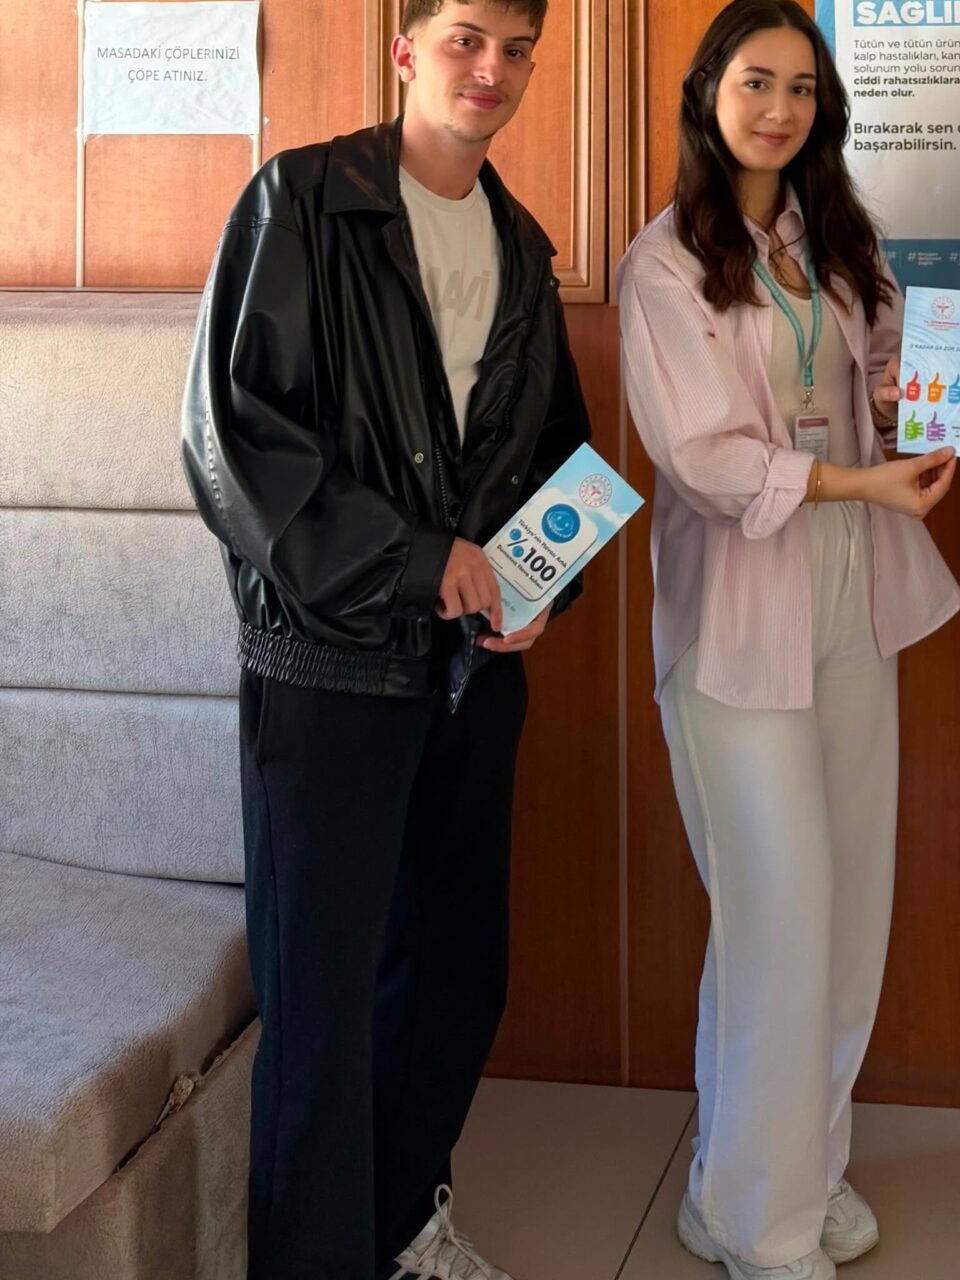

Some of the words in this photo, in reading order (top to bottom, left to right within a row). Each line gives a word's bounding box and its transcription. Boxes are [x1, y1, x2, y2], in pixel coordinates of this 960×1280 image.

[854, 39, 885, 49] Tütün
[904, 39, 933, 48] tütün
[97, 46, 161, 58] MASADAKİ
[165, 46, 240, 61] ÇÖPLERİNİZİ
[854, 52, 876, 62] kalp
[879, 51, 939, 61] hastalıkları,
[854, 64, 901, 74] solunum
[904, 64, 927, 74] yolu
[128, 67, 160, 83] ÇÖPE
[163, 70, 207, 81] ATINIZ.
[854, 76, 881, 85] ciddi
[883, 76, 960, 85] rahatsızlıklara
[854, 88, 888, 97] neden
[891, 88, 915, 97] olur.
[854, 122, 923, 134] Bırakarak
[927, 124, 953, 134] sen
[854, 139, 957, 152] başarabilirsin.
